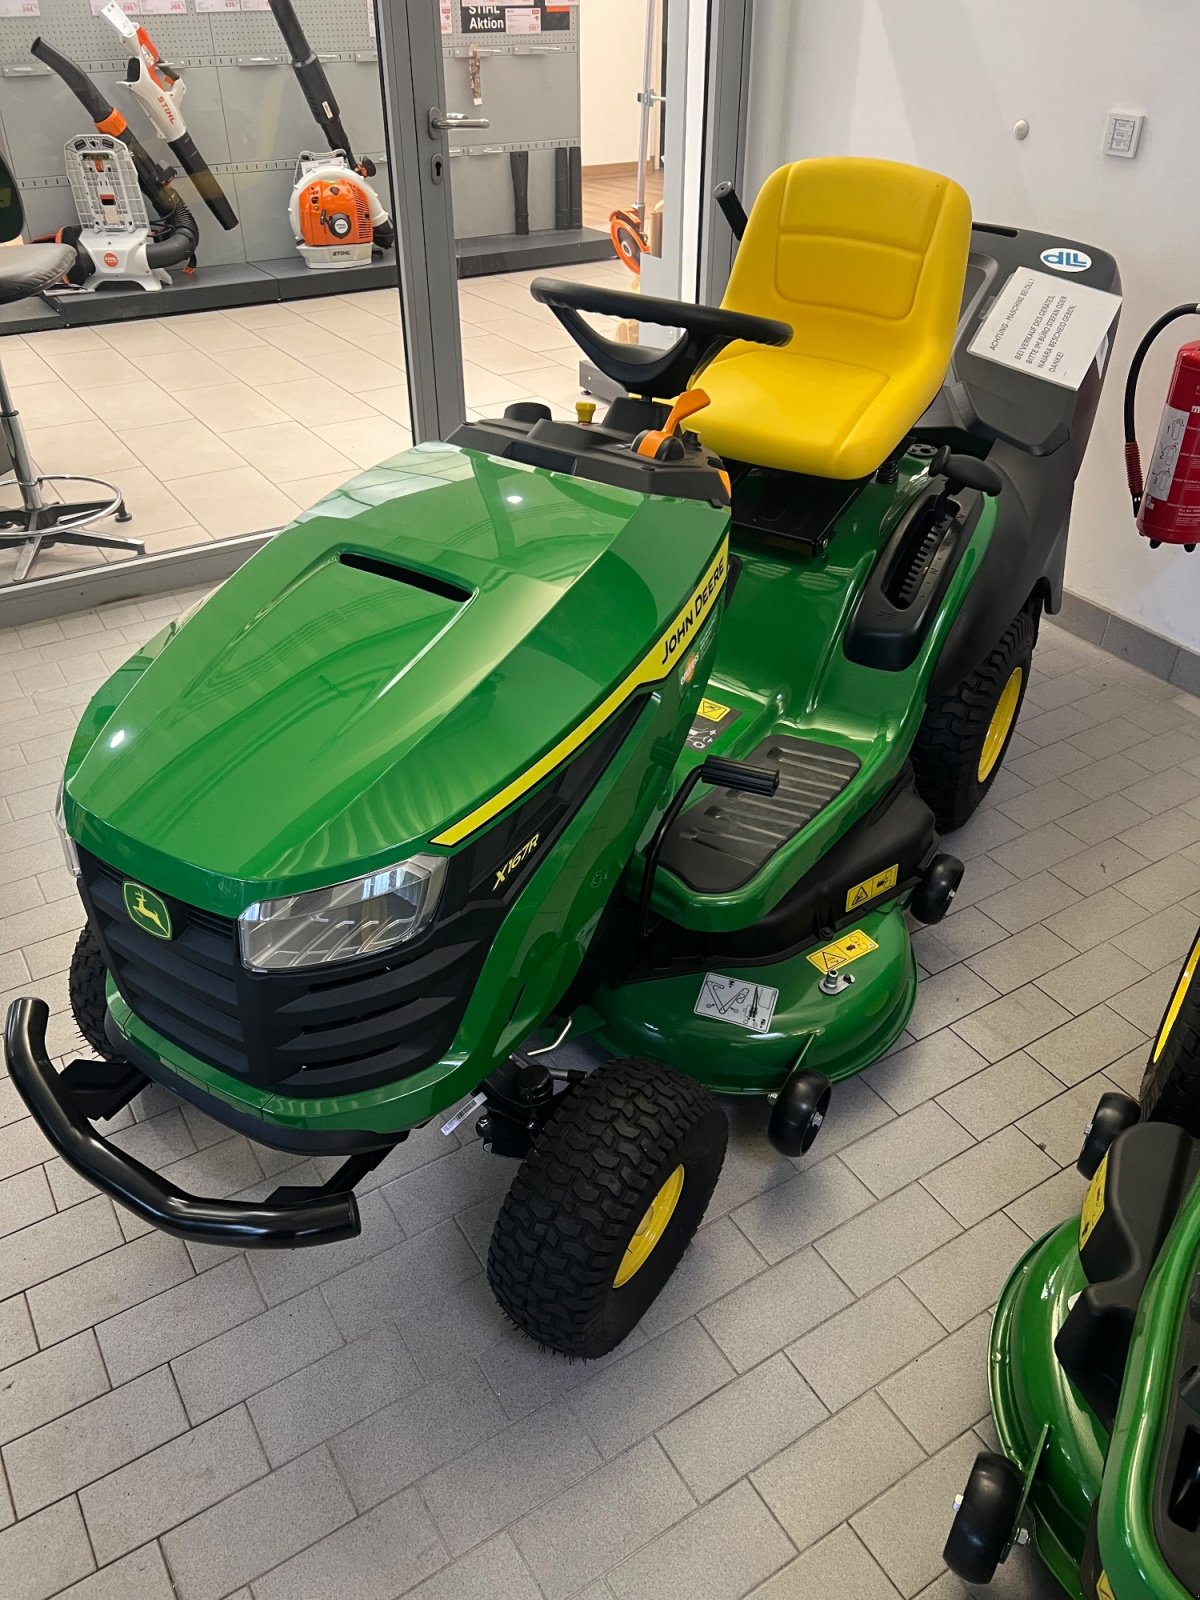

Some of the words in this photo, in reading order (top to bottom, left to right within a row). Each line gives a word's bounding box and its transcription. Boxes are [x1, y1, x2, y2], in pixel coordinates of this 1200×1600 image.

[469, 17, 504, 30] Aktion
[157, 95, 176, 125] STIHL
[1056, 295, 1067, 309] ODER
[989, 323, 1009, 350] ACHTUNG
[1005, 295, 1025, 321] MASCHINE
[1046, 308, 1061, 327] STEFAN
[1014, 349, 1024, 360] BEI
[1020, 325, 1037, 350] VERKAUF
[1033, 315, 1043, 327] DES
[1036, 325, 1050, 342] BÜRO
[1048, 321, 1066, 347] BESCHEID
[1034, 341, 1043, 349] IM
[1025, 348, 1038, 364] BITTE
[1049, 351, 1064, 372] DANKE!
[662, 609, 693, 665] JOHN
[695, 556, 724, 618] DEERE
[491, 832, 540, 891] X167R
